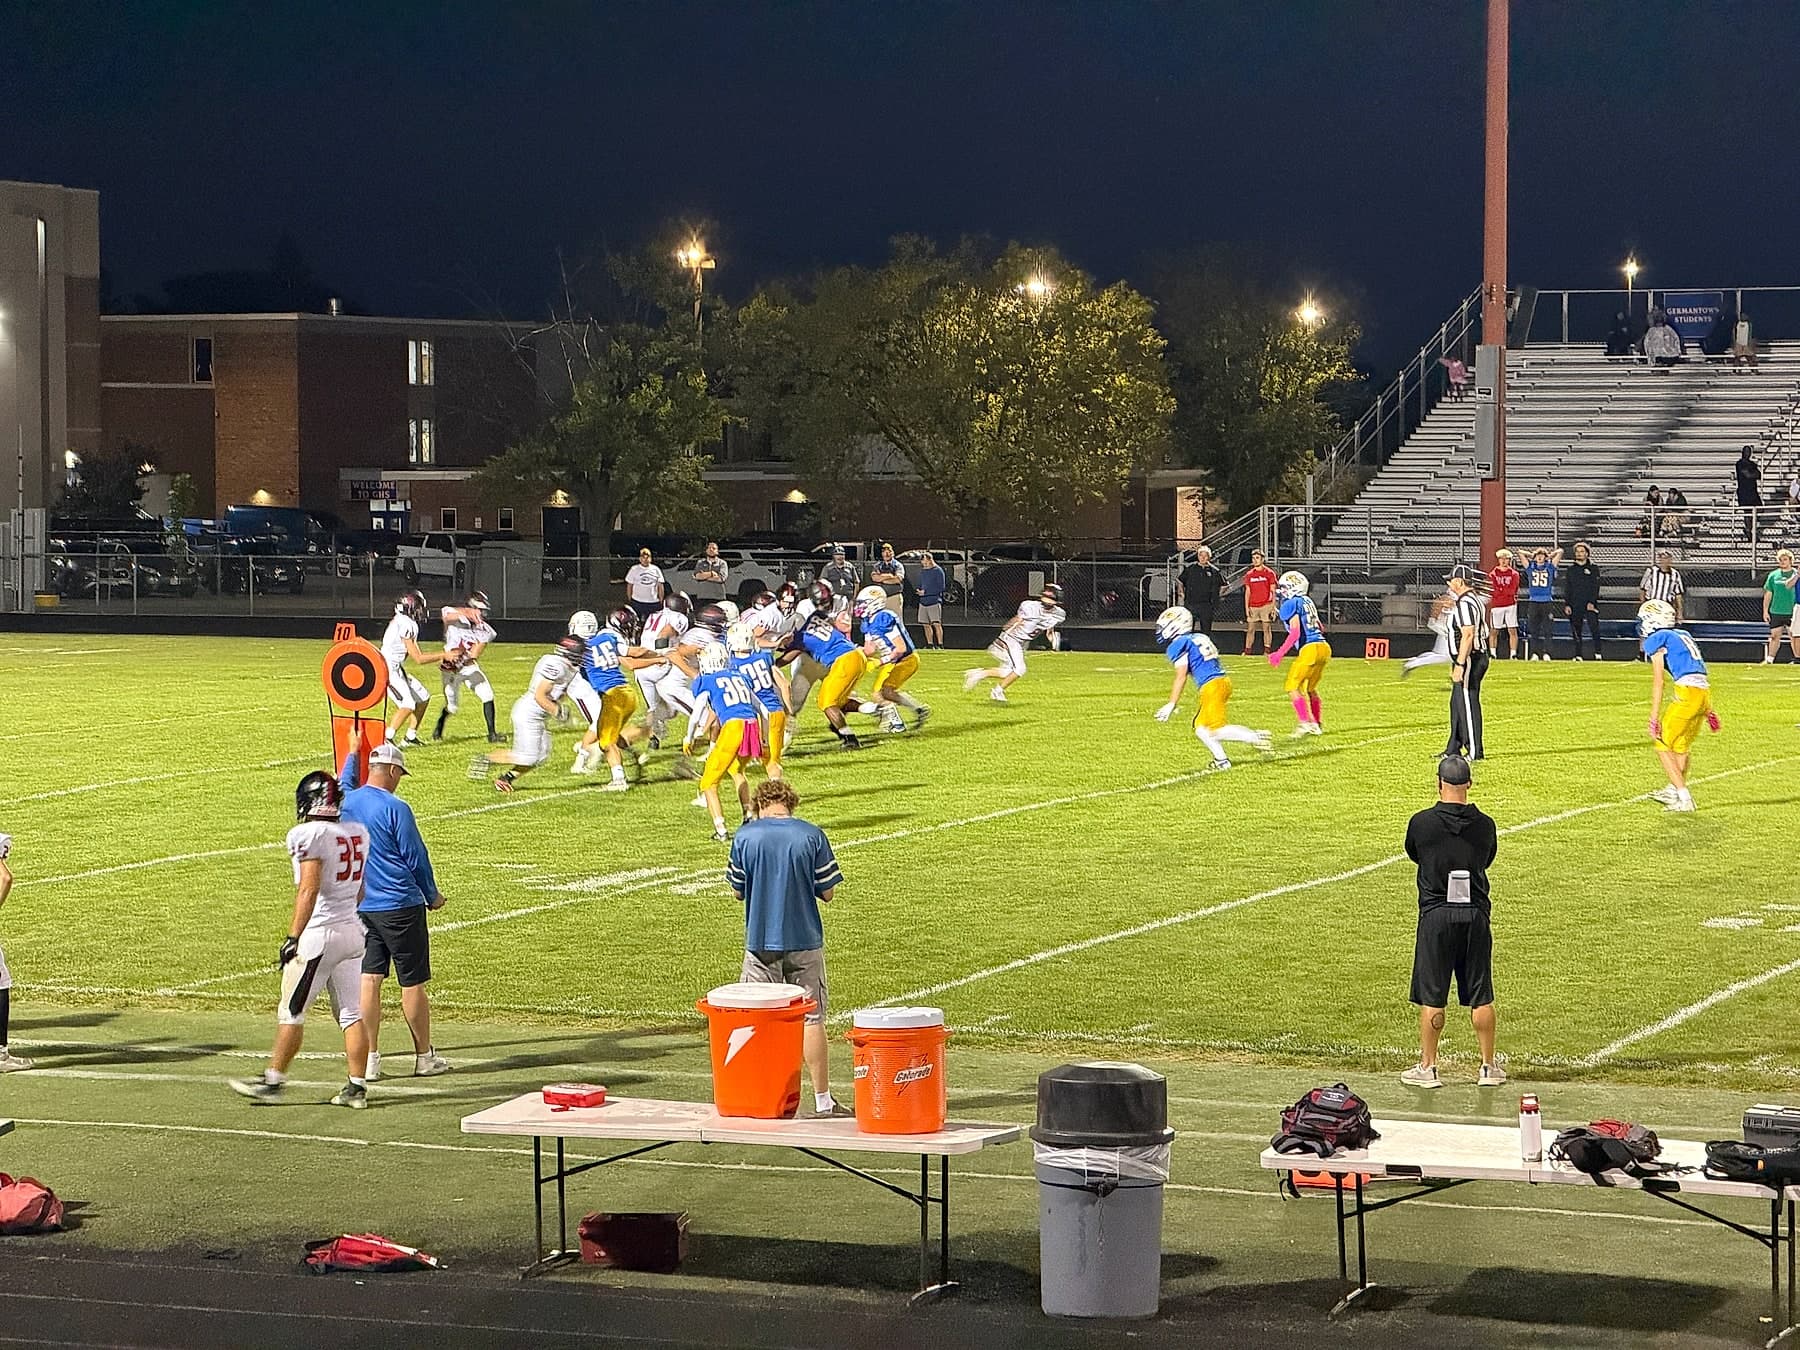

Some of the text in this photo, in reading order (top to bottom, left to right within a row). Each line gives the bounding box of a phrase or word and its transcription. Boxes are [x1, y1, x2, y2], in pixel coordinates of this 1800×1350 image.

[352, 481, 396, 489] WELCOME
[358, 490, 390, 499] TO GHS
[1531, 571, 1549, 587] 35
[336, 626, 351, 641] 10
[591, 640, 619, 671] 46
[1367, 641, 1387, 658] 30
[715, 676, 752, 707] 36
[336, 835, 364, 881] 35
[896, 1066, 931, 1082] Gatorade
